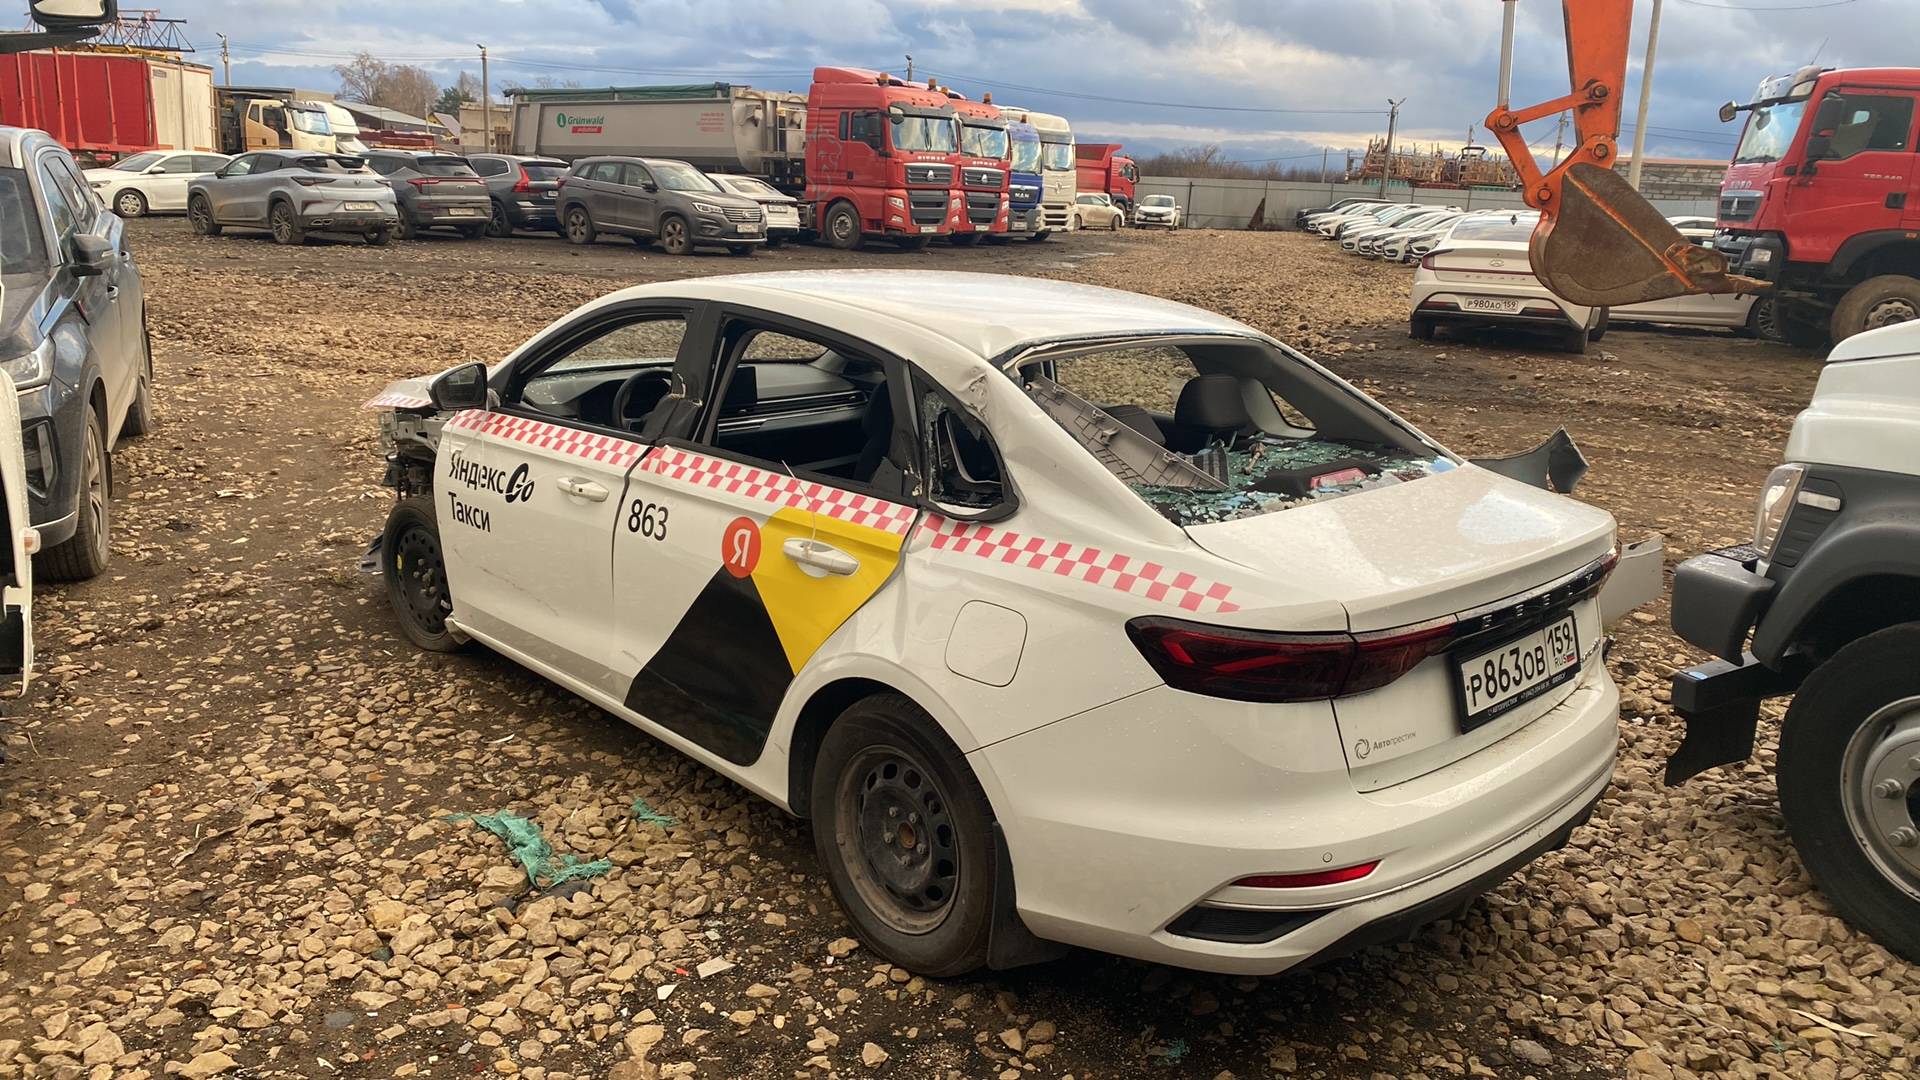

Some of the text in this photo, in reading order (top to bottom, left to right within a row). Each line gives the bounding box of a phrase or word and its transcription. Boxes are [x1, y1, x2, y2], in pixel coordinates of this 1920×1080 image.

[449, 450, 535, 503] Яндекс Go
[448, 491, 491, 532] Такси
[628, 499, 669, 541] 863
[730, 528, 752, 567] Я
[1470, 646, 1546, 707] Р863ОВ
[1547, 622, 1571, 658] 159
[1555, 653, 1567, 668] RUS
